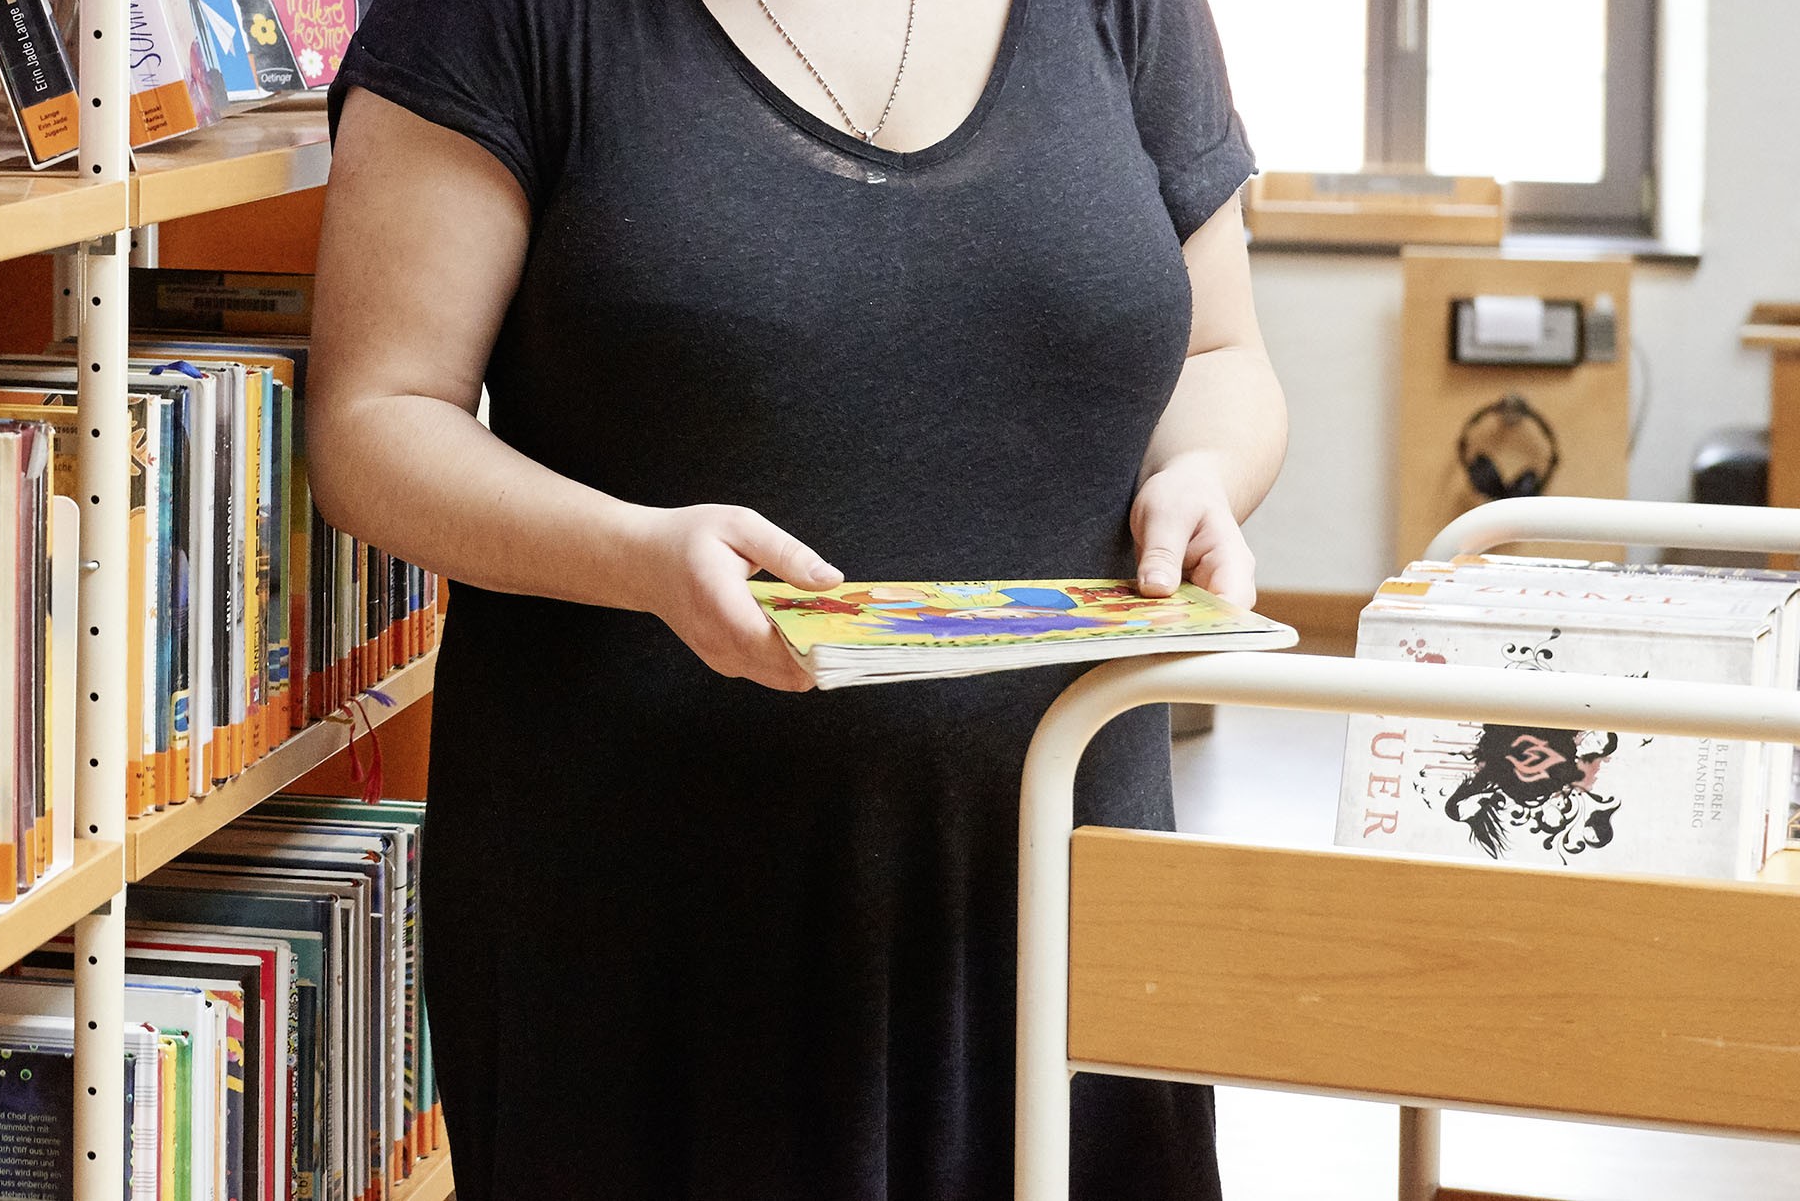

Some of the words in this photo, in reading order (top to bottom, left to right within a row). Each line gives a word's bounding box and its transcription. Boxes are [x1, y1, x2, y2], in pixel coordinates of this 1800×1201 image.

[10, 7, 31, 42] Lange
[23, 42, 43, 68] Jade
[32, 68, 48, 93] Erin
[138, 73, 161, 88] IN
[260, 72, 293, 85] Oetinger
[44, 125, 69, 139] Jugend
[1715, 743, 1730, 756] B.
[1362, 728, 1408, 840] UER
[1691, 737, 1712, 829] STRANDBERG
[1710, 760, 1728, 822] ELFGREN
[7, 1112, 26, 1120] Chad
